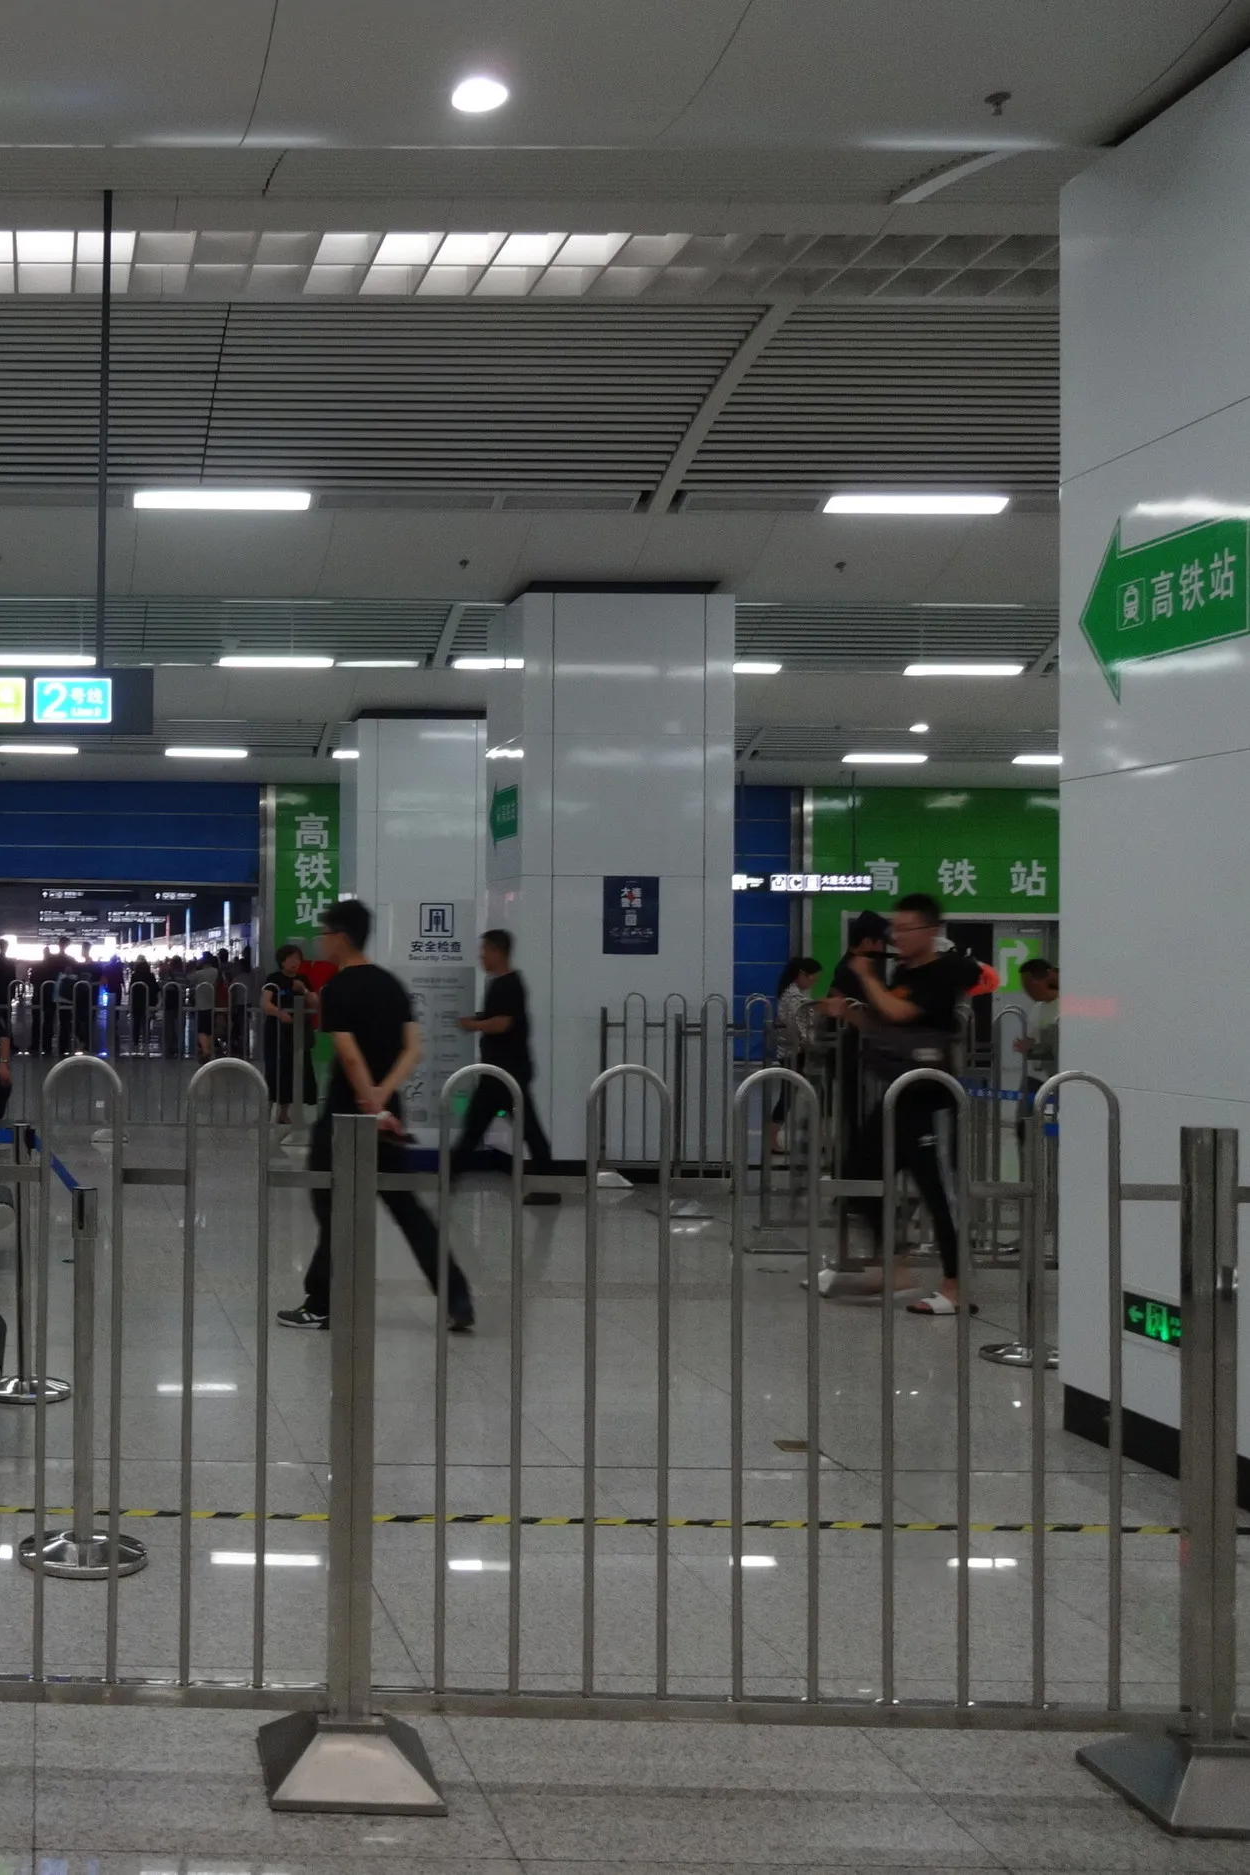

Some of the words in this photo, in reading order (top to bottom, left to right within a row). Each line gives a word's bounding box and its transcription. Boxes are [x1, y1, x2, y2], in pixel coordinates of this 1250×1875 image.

[1150, 547, 1237, 622] 高铁站
[294, 812, 333, 928] 高铁站
[864, 857, 1047, 897] 高铁站
[408, 953, 440, 962] Security
[410, 940, 462, 953] 安全检查
